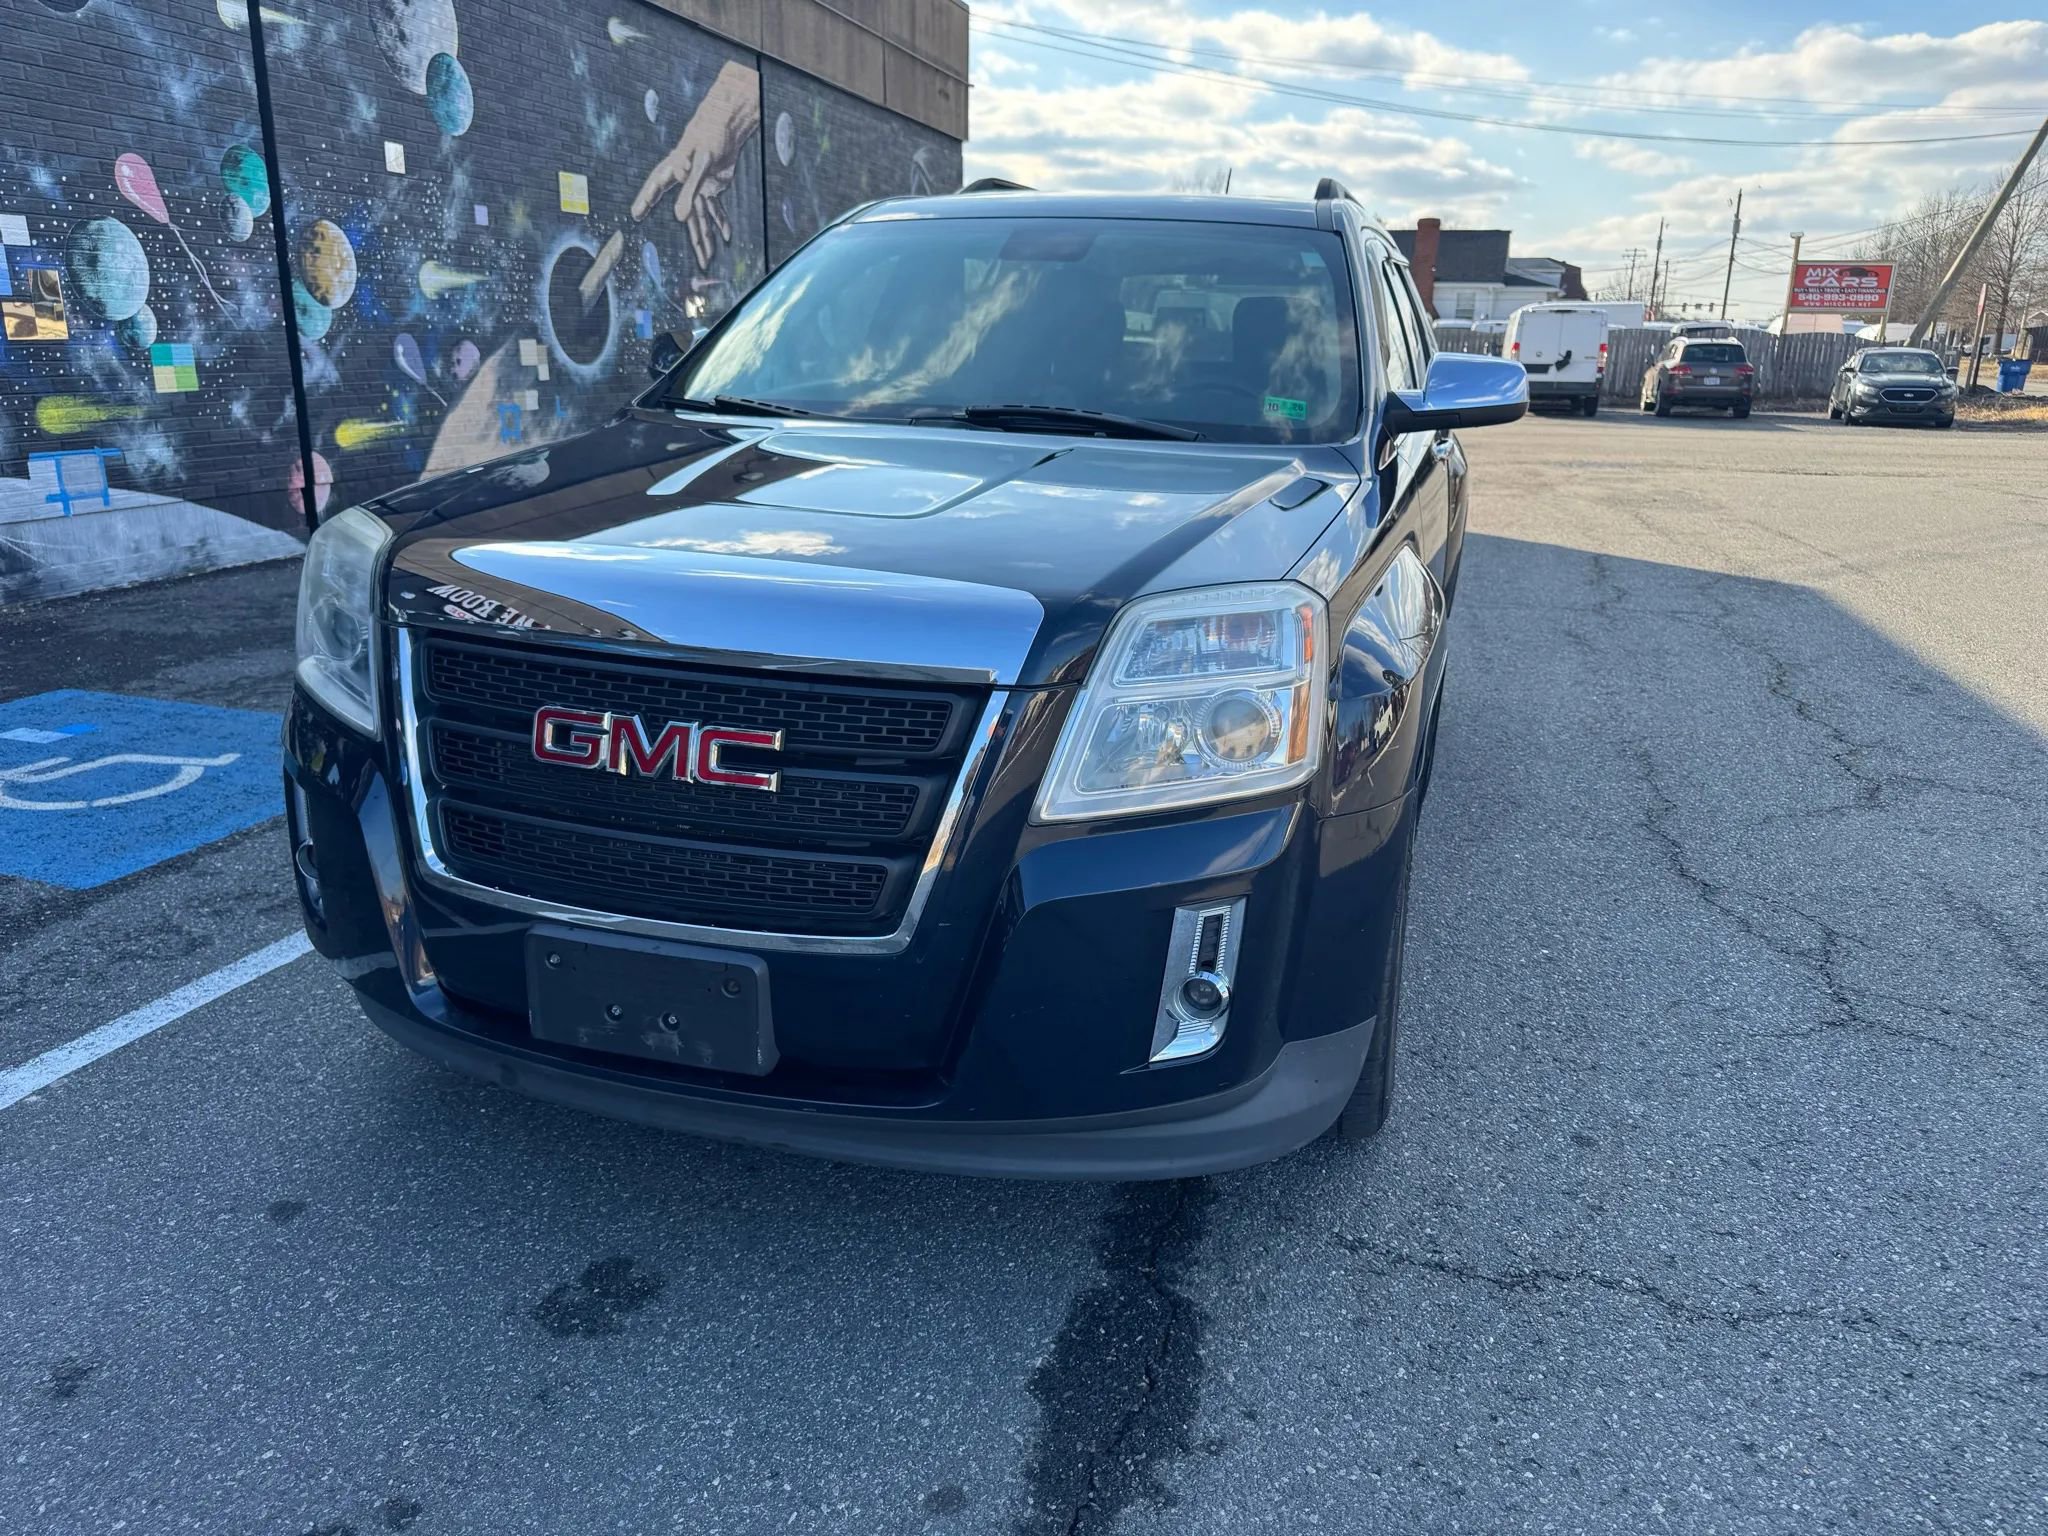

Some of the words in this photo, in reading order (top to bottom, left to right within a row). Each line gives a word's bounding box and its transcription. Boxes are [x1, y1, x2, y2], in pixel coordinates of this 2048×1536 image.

[1806, 268, 1840, 277] MIX
[1804, 277, 1878, 287] CARS
[533, 705, 784, 792] GMC
